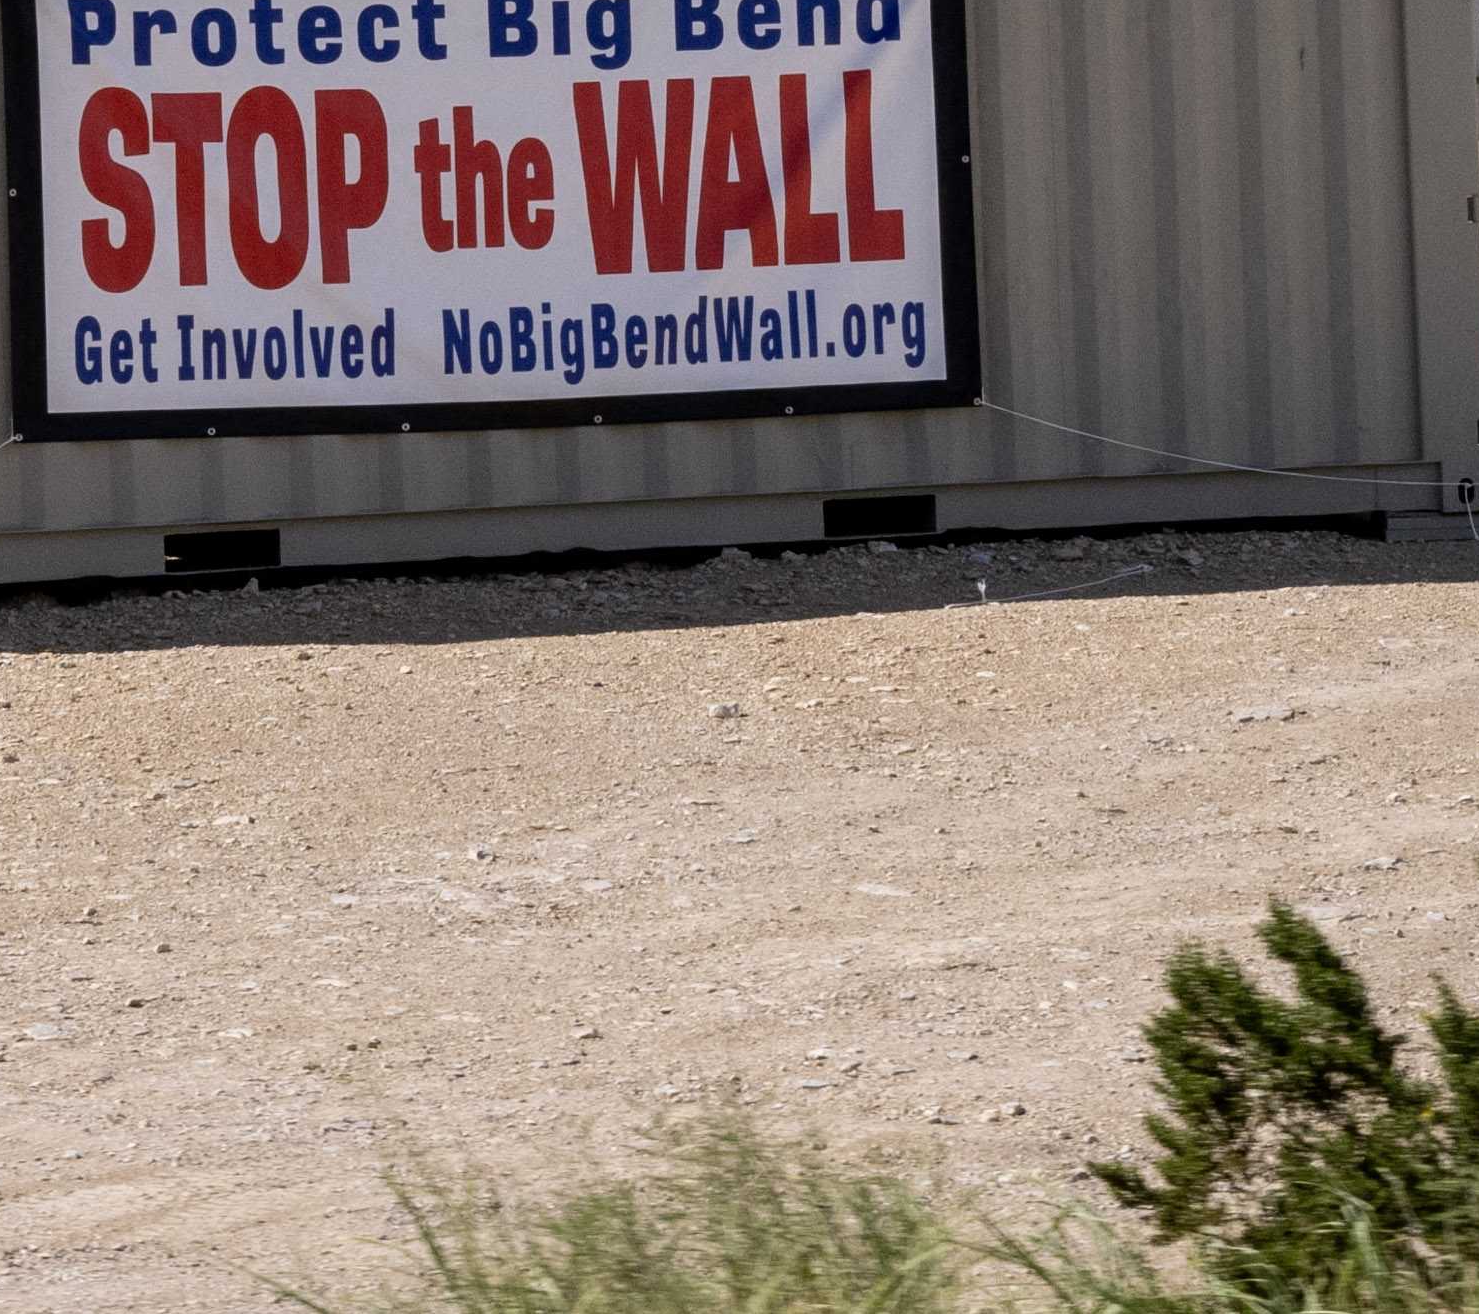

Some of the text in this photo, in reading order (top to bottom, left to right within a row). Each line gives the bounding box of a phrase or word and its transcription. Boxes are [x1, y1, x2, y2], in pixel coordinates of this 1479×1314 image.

[79, 70, 905, 292] STOP the WALL
[76, 290, 926, 384] Get Involved NoBigBendWall.org
